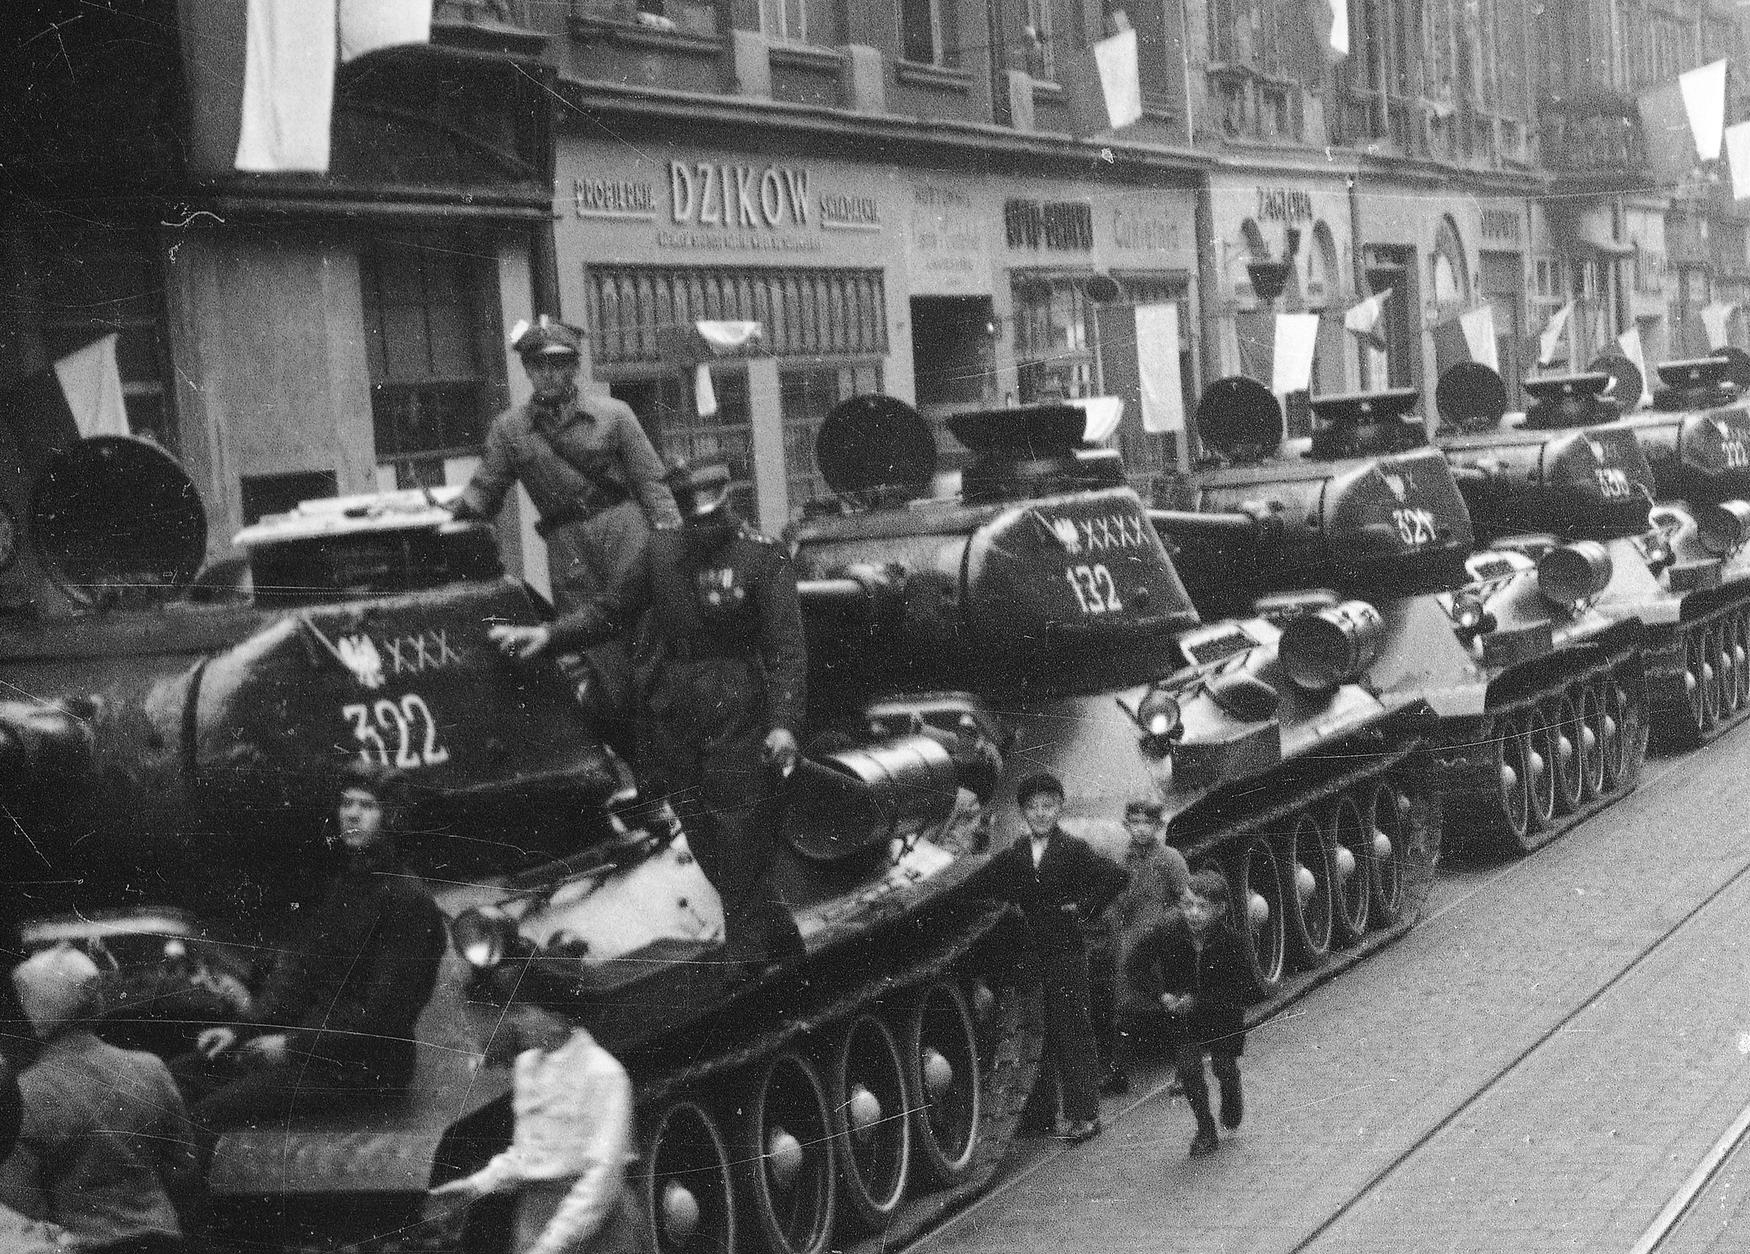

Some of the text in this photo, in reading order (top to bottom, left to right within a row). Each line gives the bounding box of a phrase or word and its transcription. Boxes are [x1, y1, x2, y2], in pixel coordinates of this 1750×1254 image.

[668, 159, 811, 227] DZIKÓW
[1078, 513, 1150, 552] XXXX
[1065, 563, 1125, 614] 132
[384, 629, 464, 676] XXX
[342, 693, 450, 770] 322
